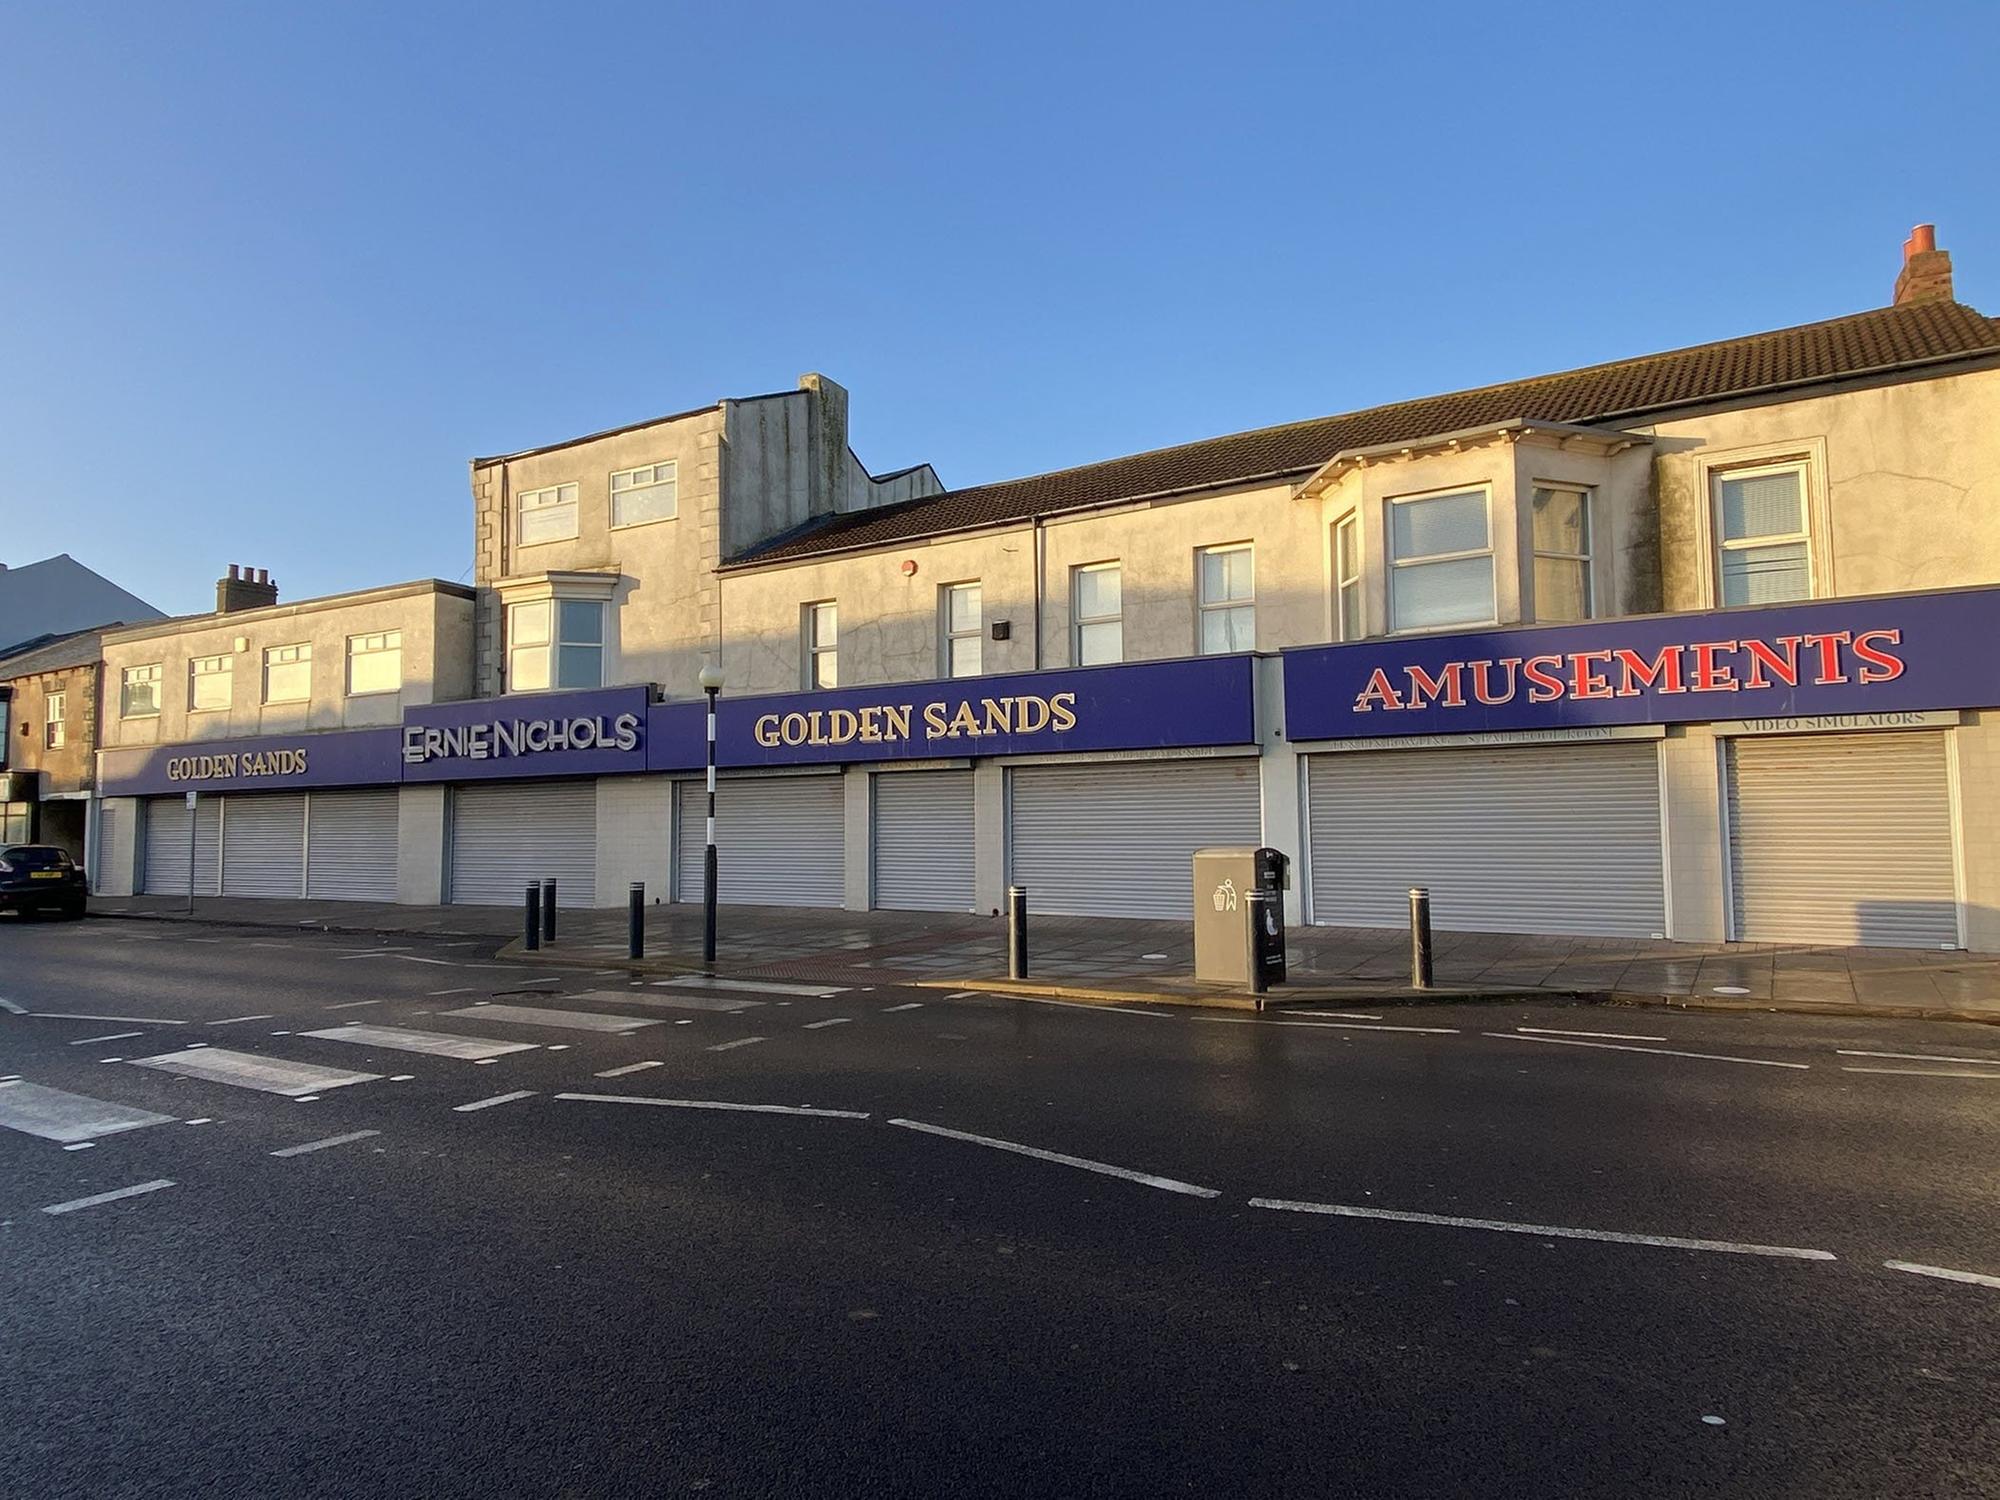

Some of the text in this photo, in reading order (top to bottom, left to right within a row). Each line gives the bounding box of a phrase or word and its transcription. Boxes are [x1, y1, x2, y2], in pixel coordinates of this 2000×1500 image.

[1353, 628, 1904, 712] AMUSEMENTS
[402, 713, 639, 763] ERNIE NICHOLS
[754, 692, 1077, 747] GOLDEN SANDS
[1742, 711, 1925, 732] VIDEO SIMULATORS
[166, 748, 308, 781] GOLDEN SANDS
